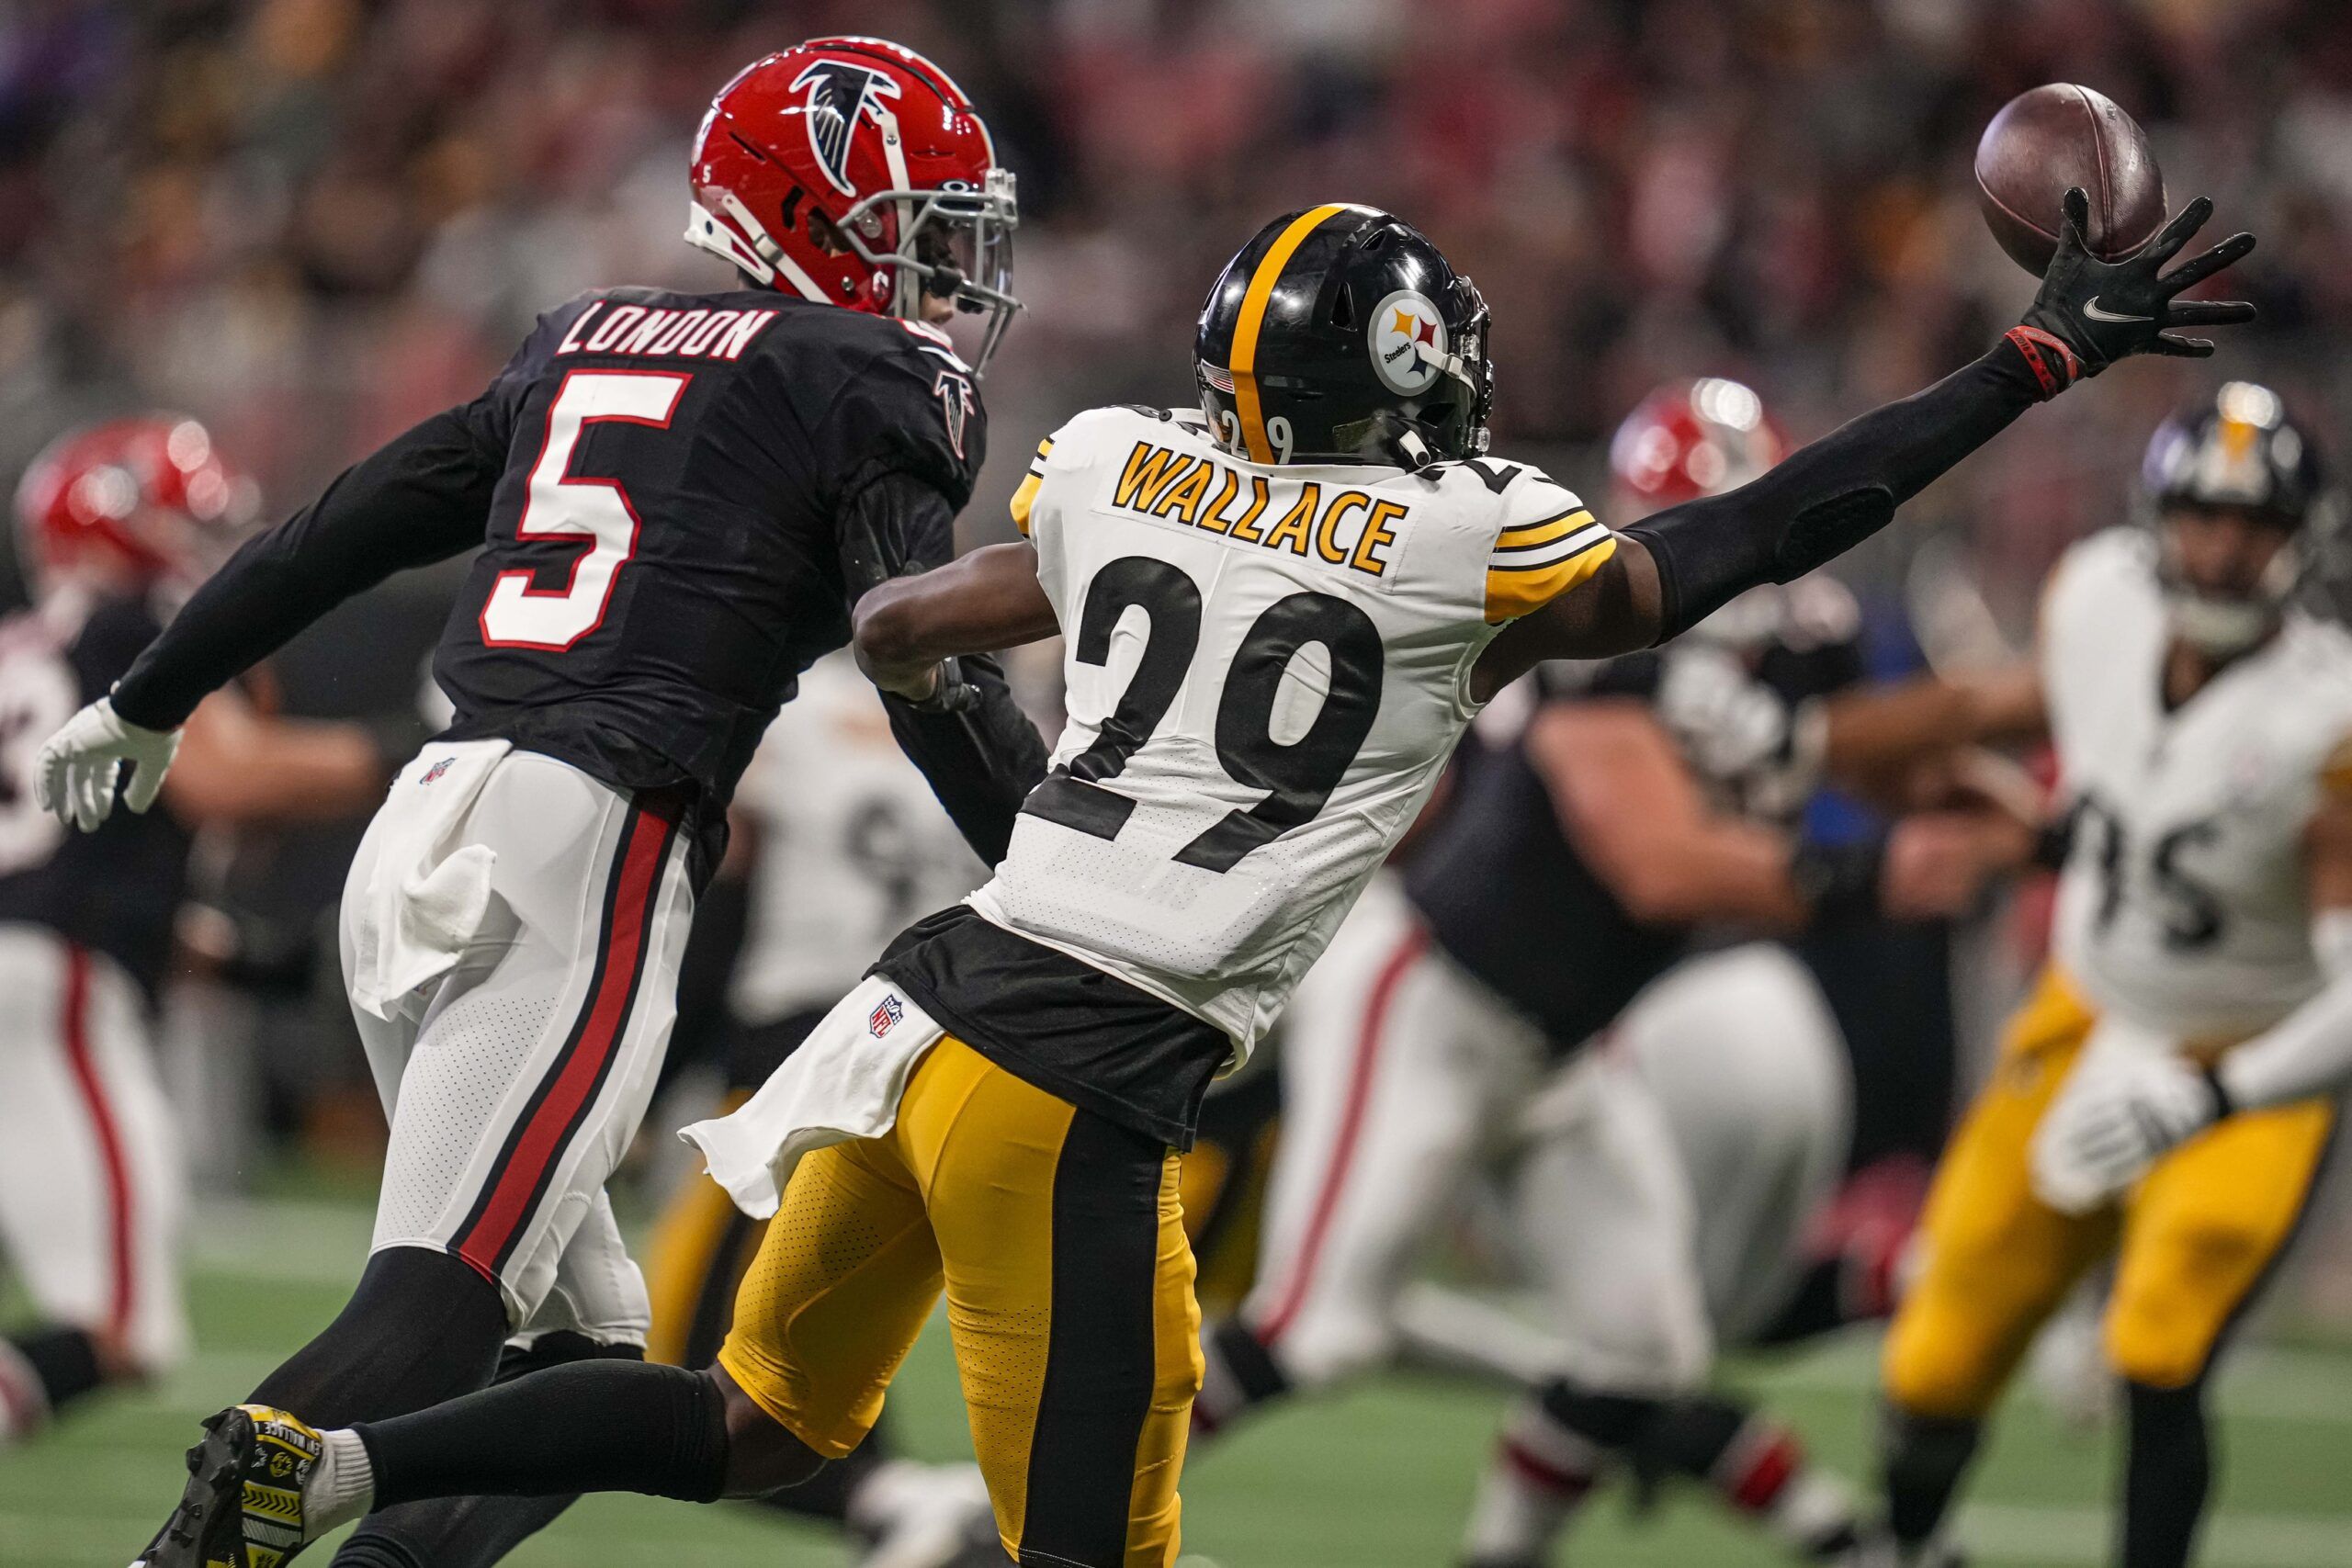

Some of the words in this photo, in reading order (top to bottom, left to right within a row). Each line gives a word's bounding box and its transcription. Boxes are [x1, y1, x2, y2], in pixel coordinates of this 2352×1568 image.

[702, 164, 712, 184] 5
[555, 300, 779, 360] LONDON
[1384, 342, 1411, 364] Steelers
[1222, 410, 1294, 466] 29
[479, 369, 694, 653] 5
[1113, 441, 1409, 579] WALLACE
[1017, 555, 1385, 874] 29
